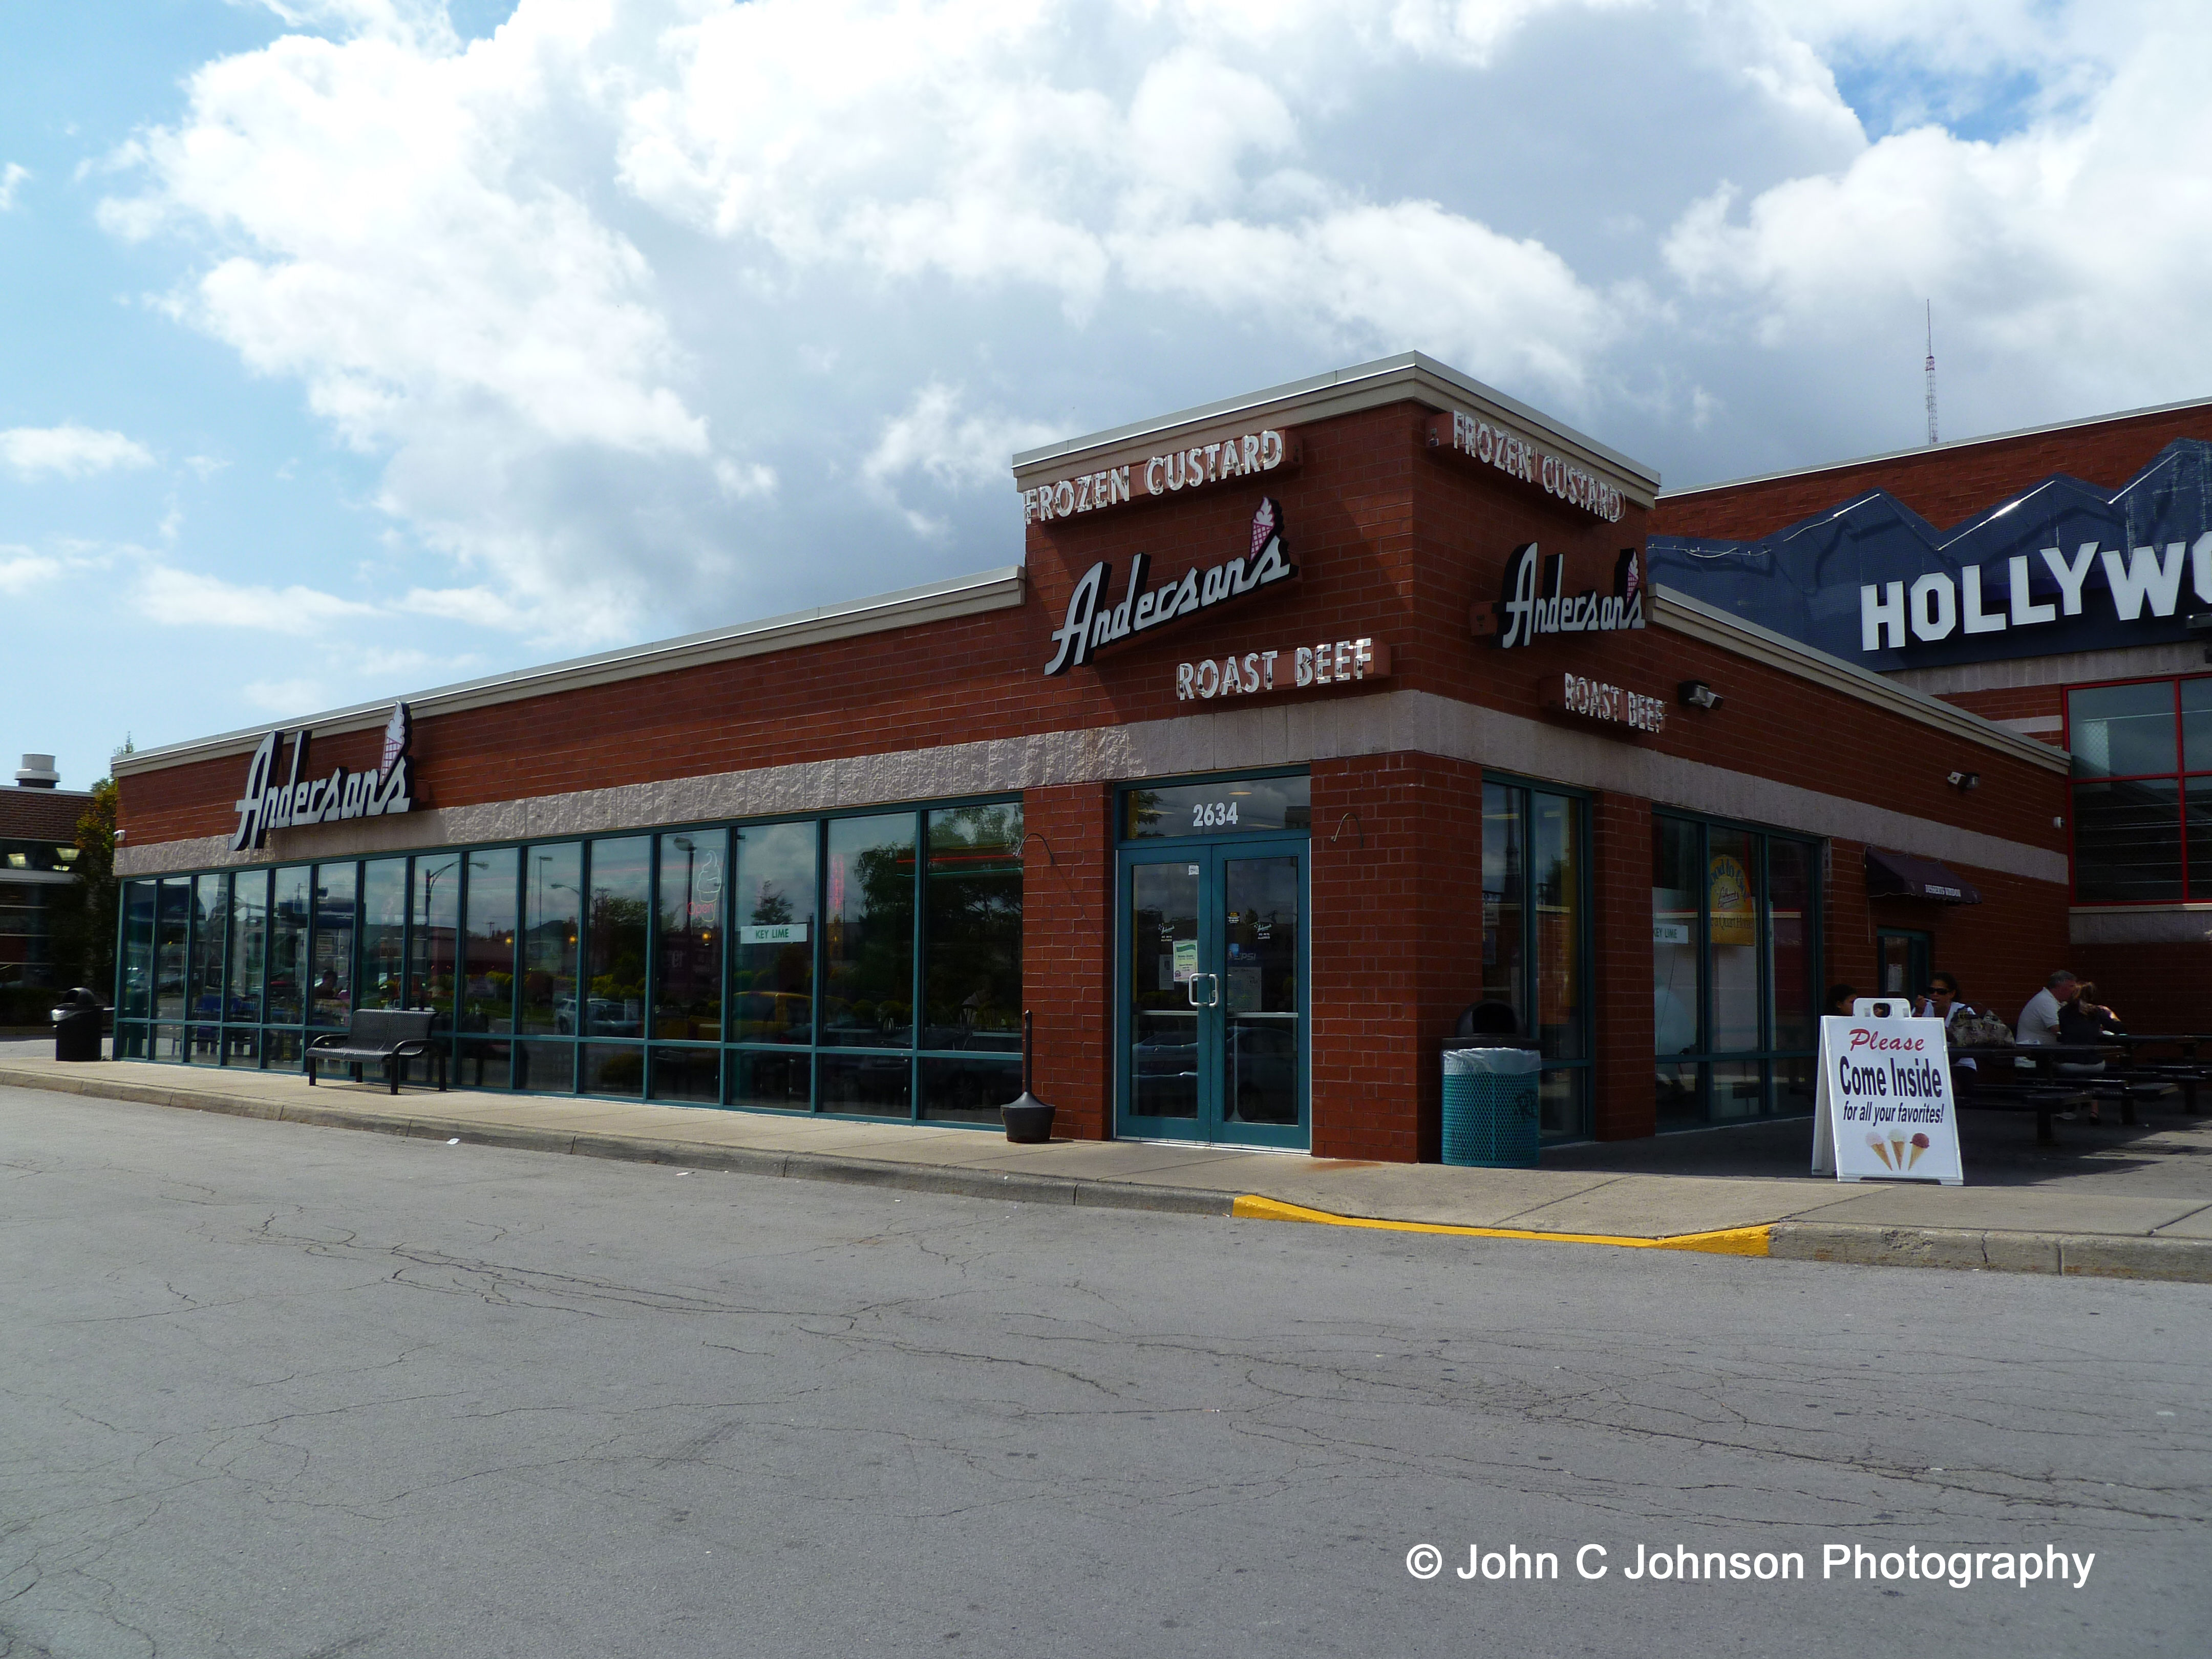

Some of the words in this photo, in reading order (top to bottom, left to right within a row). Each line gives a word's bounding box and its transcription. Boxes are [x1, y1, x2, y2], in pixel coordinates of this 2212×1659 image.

[1024, 465, 1130, 524] FROZEN
[1144, 431, 1283, 495] CUSTARD
[1454, 410, 1537, 483] FROZEN
[1542, 455, 1625, 523] CUSTARD
[1177, 650, 1278, 700] ROAST
[1294, 637, 1371, 687] BEEF
[1565, 672, 1624, 722] ROAST
[1627, 691, 1667, 733] BEEF
[1193, 802, 1238, 826] 2634
[687, 901, 714, 919] Open
[756, 929, 769, 939] KEY
[772, 928, 789, 938] LIME
[1665, 928, 1677, 939] LIME
[1849, 1028, 1925, 1051] Please
[1839, 1055, 1886, 1096] Come
[1890, 1057, 1942, 1097] Inside
[1843, 1100, 1857, 1121] for
[1859, 1101, 1871, 1121] all
[1873, 1107, 1896, 1126] your
[1898, 1102, 1945, 1123] favorites!
